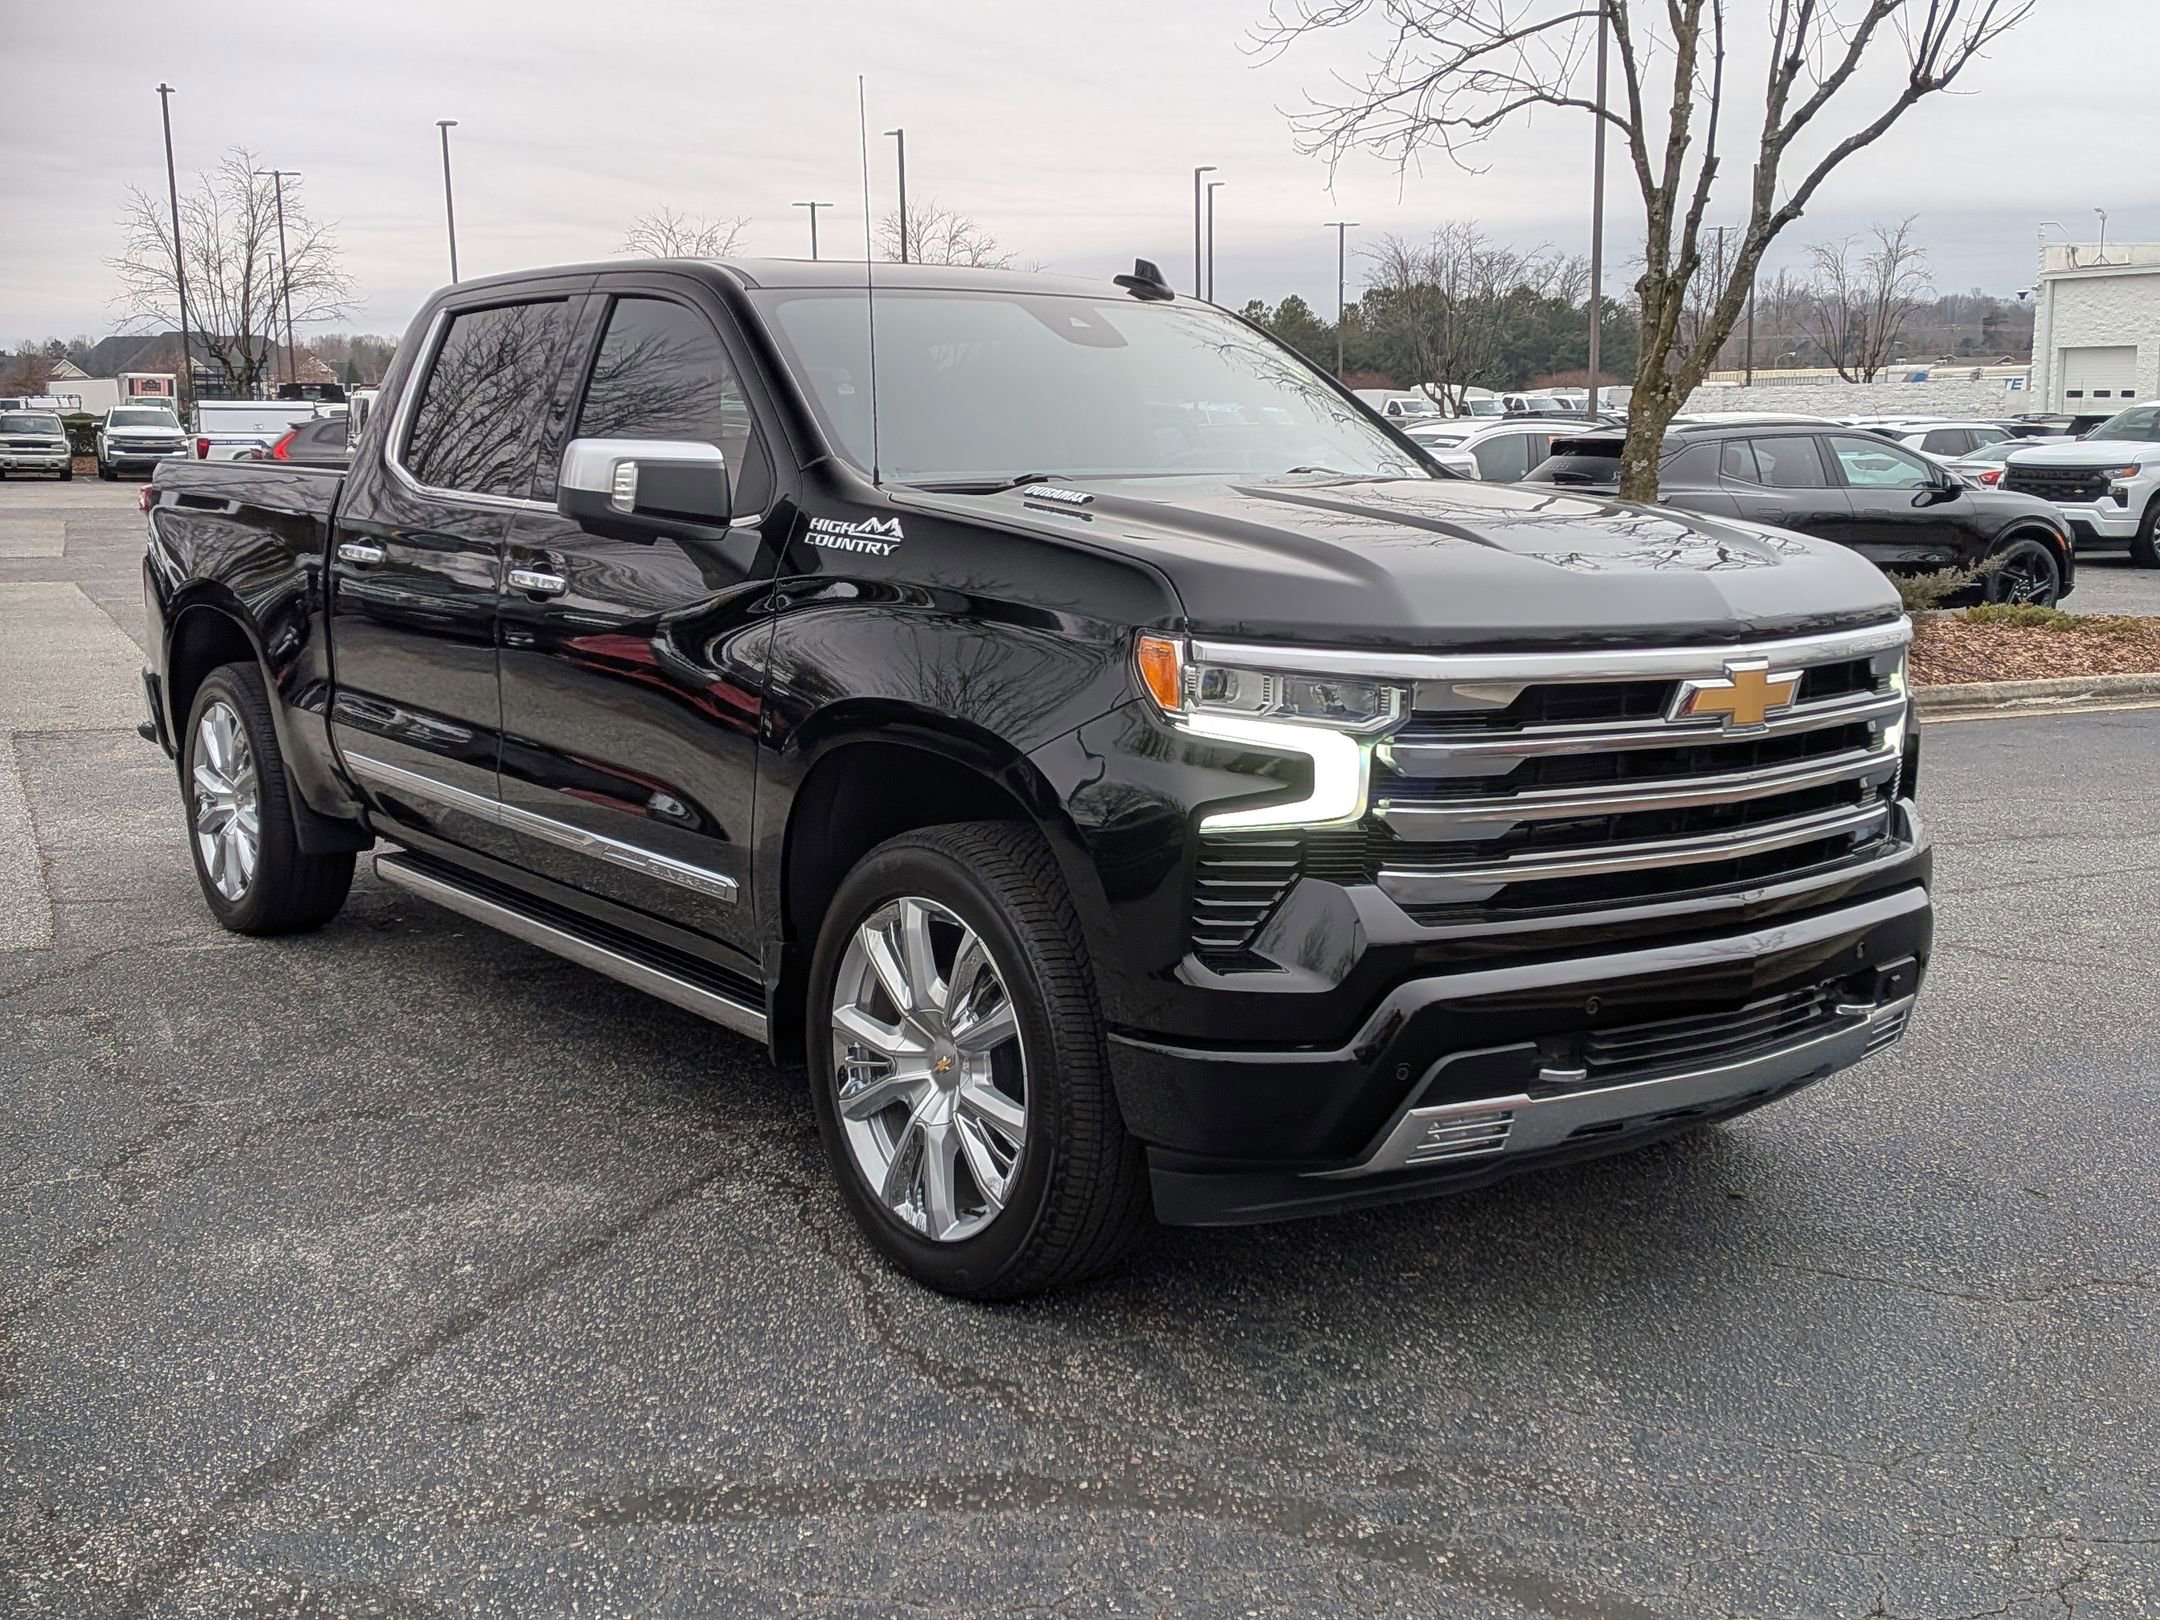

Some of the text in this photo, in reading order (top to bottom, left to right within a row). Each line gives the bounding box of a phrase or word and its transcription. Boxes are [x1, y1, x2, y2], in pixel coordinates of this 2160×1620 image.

[1023, 485, 1088, 504] DURAMAX
[809, 517, 859, 534] HIGH
[804, 532, 900, 556] COUNTRY
